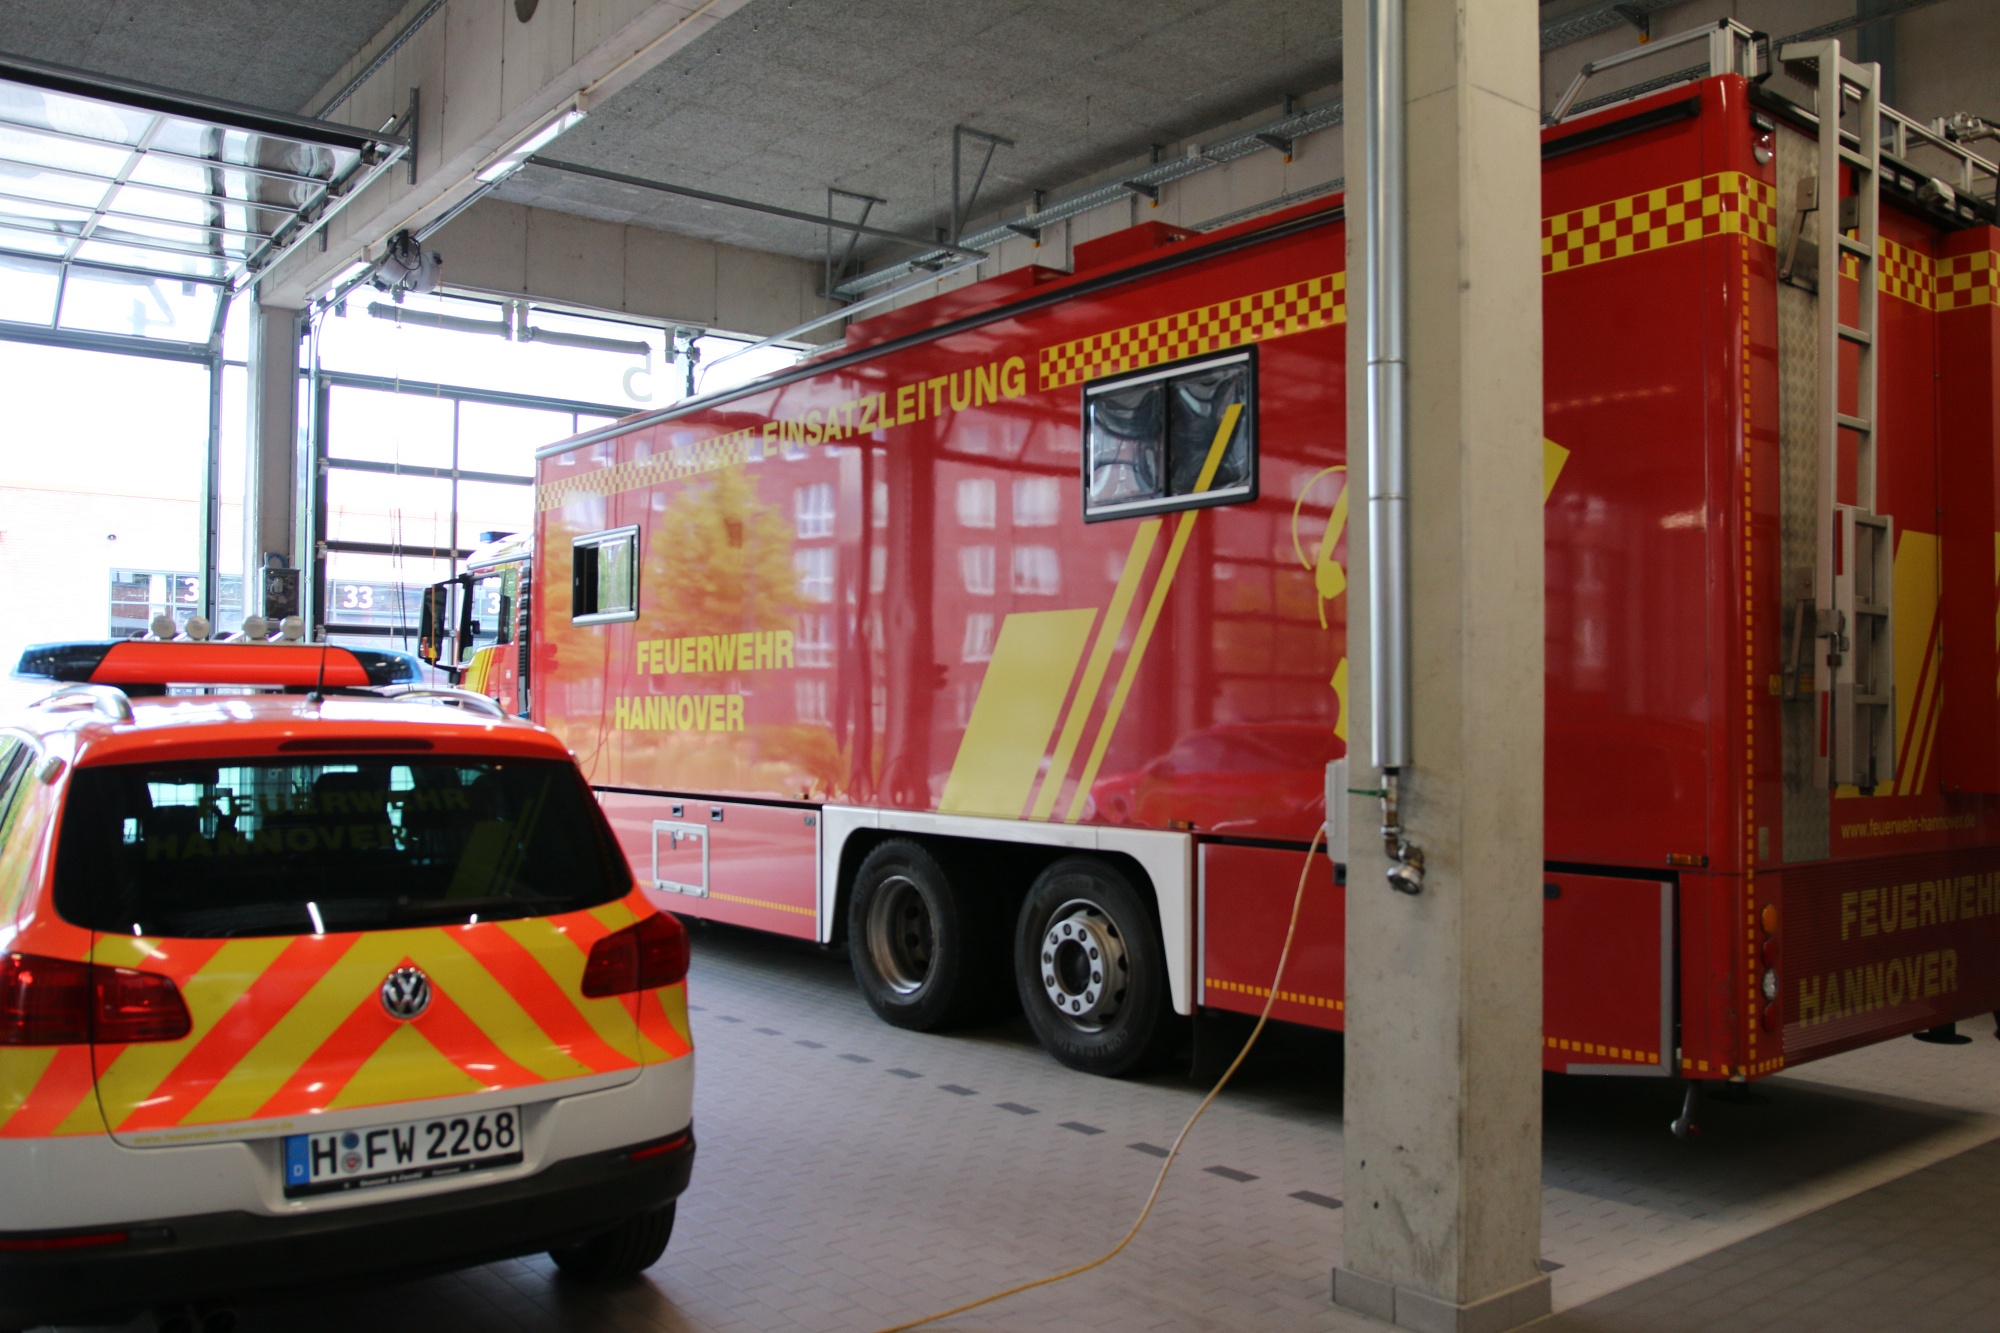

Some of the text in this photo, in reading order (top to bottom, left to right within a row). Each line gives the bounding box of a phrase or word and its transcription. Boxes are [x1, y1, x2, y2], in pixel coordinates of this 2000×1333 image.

[762, 355, 1026, 458] EINSATZLEITUNG
[343, 585, 373, 609] 33
[637, 630, 794, 675] FEUERWEHR
[615, 694, 744, 732] HANNOVER
[198, 786, 469, 819] FEUERWEHR
[146, 824, 407, 861] HANNOVER
[1841, 813, 1976, 838] www.feuerwehr-hannover.de
[383, 969, 430, 1018] VW
[1799, 948, 1957, 1028] HANNOVER
[311, 1112, 515, 1176] H FW 2268
[293, 1164, 303, 1177] D
